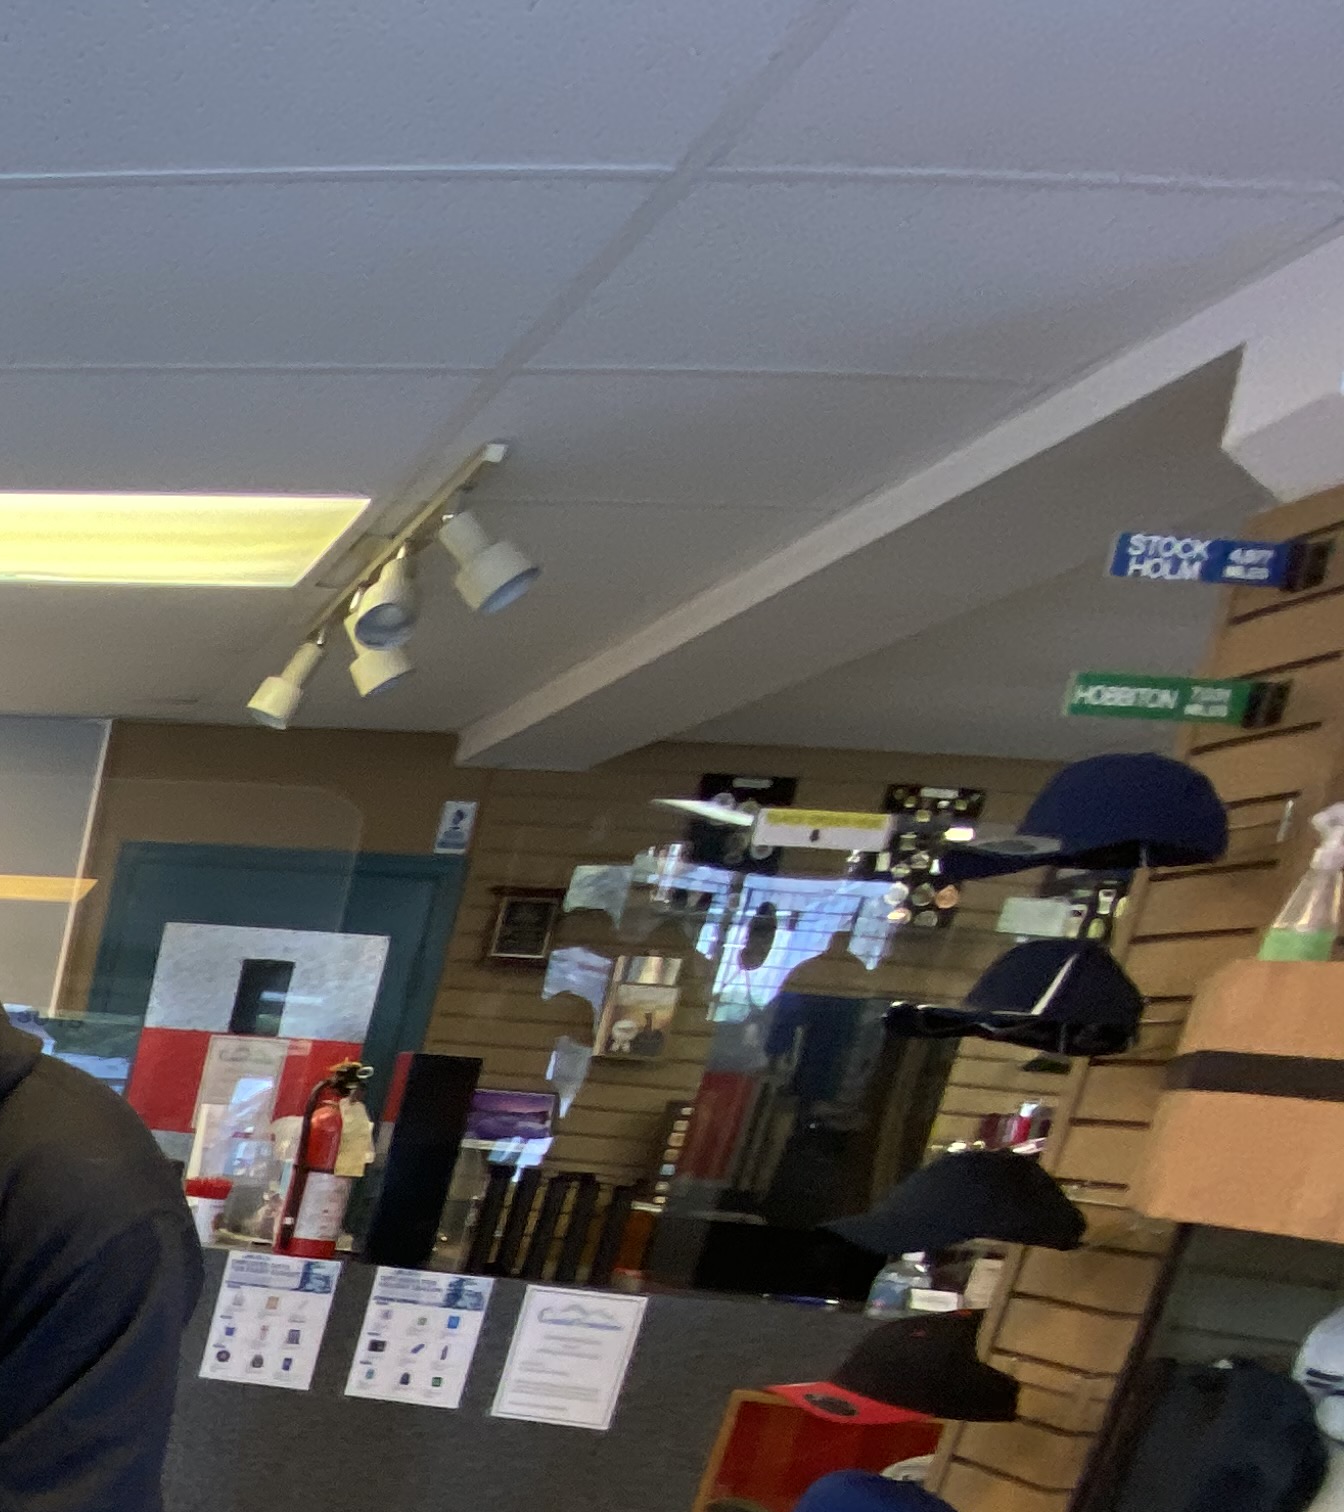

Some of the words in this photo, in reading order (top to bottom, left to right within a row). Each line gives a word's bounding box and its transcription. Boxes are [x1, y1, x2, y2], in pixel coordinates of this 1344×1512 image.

[1128, 533, 1211, 561] STOCK
[1127, 556, 1203, 580] HOLM
[1075, 685, 1180, 709] HOBBITON
